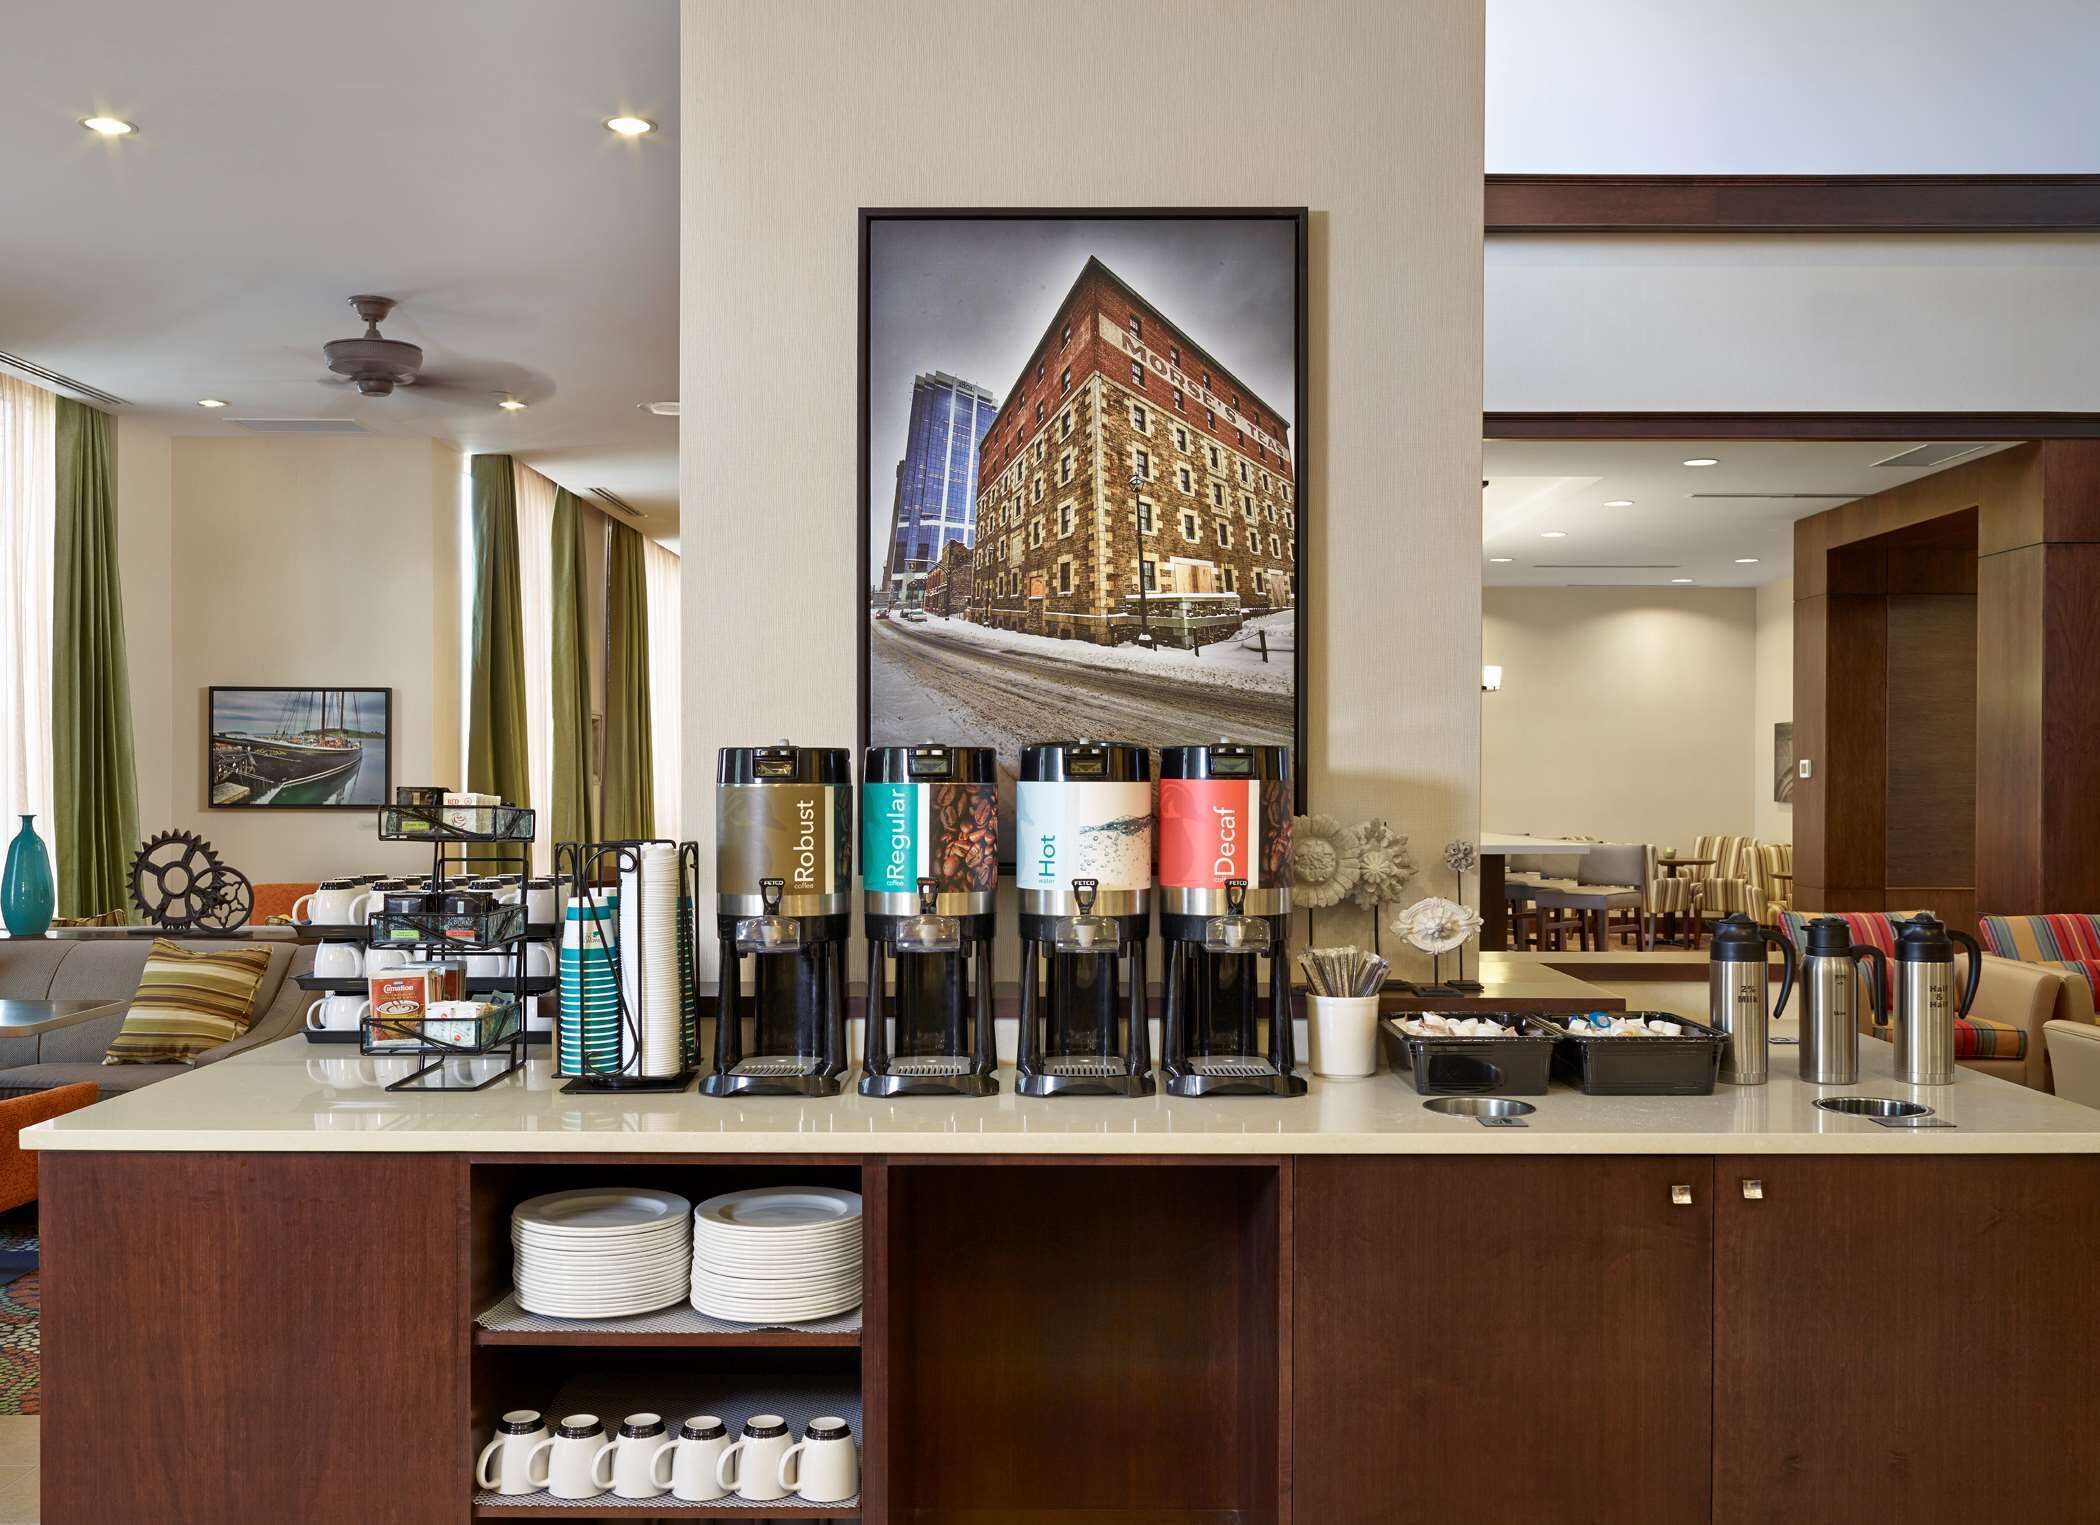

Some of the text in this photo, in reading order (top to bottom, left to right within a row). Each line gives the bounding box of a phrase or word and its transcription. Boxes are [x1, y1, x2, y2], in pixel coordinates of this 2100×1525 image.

[1121, 332, 1285, 458] MORSE'S TEAS
[793, 799, 814, 881] Robust
[887, 788, 911, 879] Regular
[1038, 834, 1056, 877] Hot
[1212, 805, 1235, 876] Decaf
